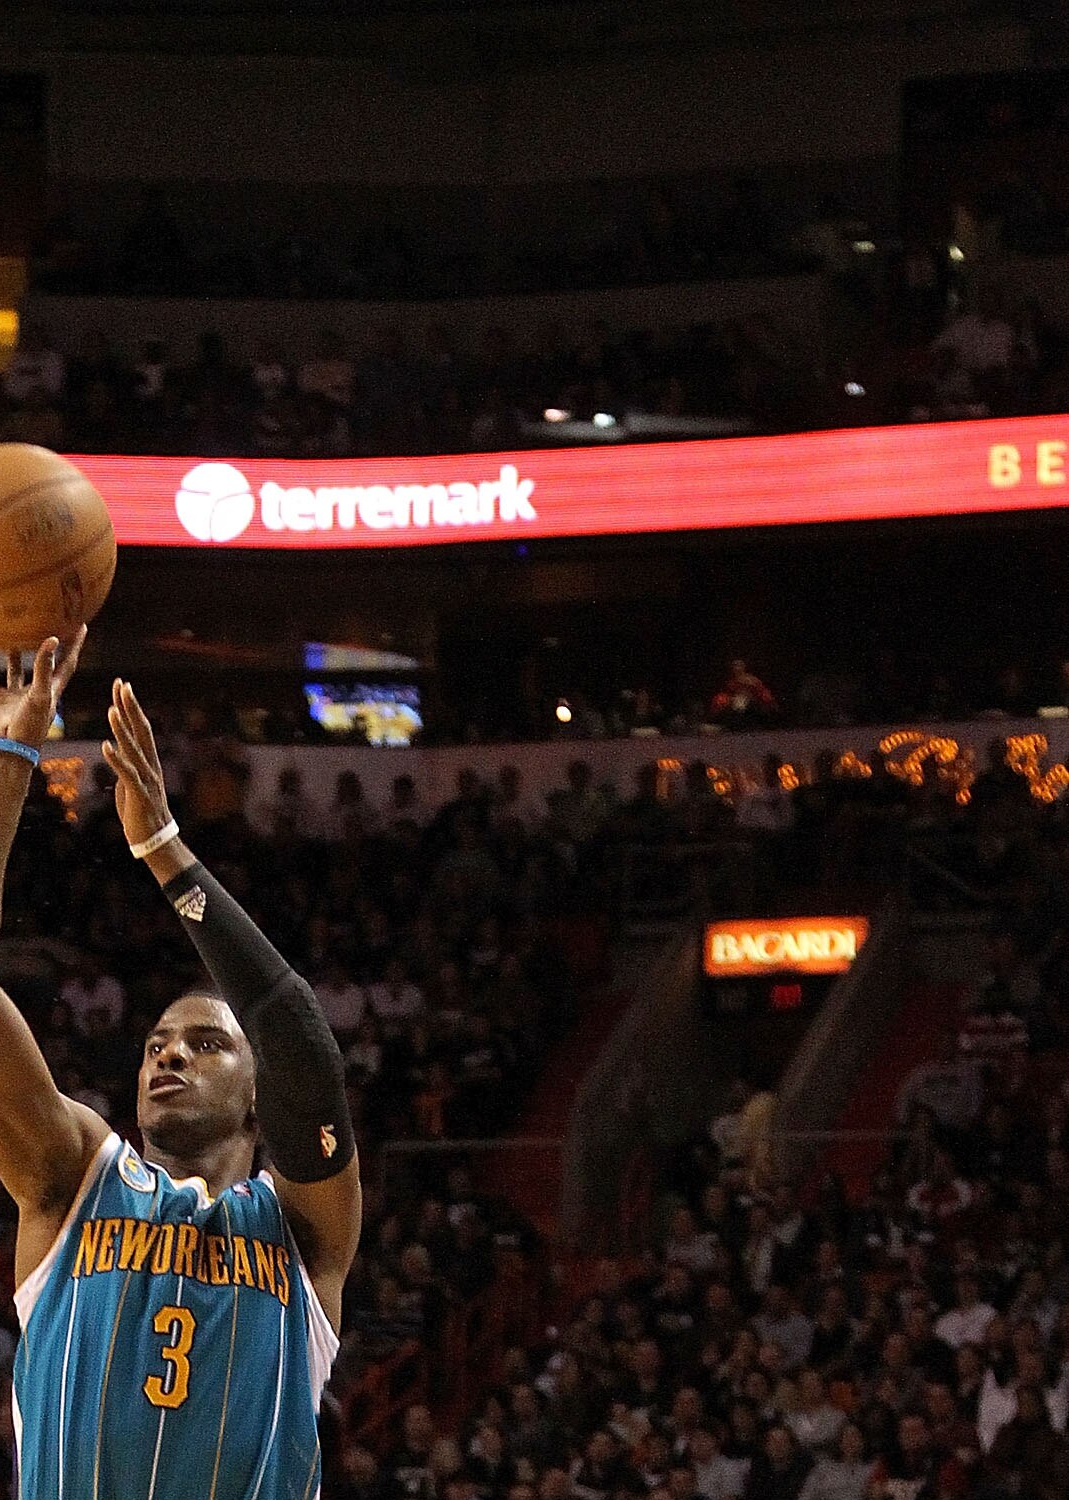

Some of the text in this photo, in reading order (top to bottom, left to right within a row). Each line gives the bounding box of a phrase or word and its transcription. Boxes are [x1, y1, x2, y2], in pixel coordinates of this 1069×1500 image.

[259, 464, 537, 531] terremark
[712, 929, 856, 960] BACARDI
[142, 1304, 196, 1409] 3
